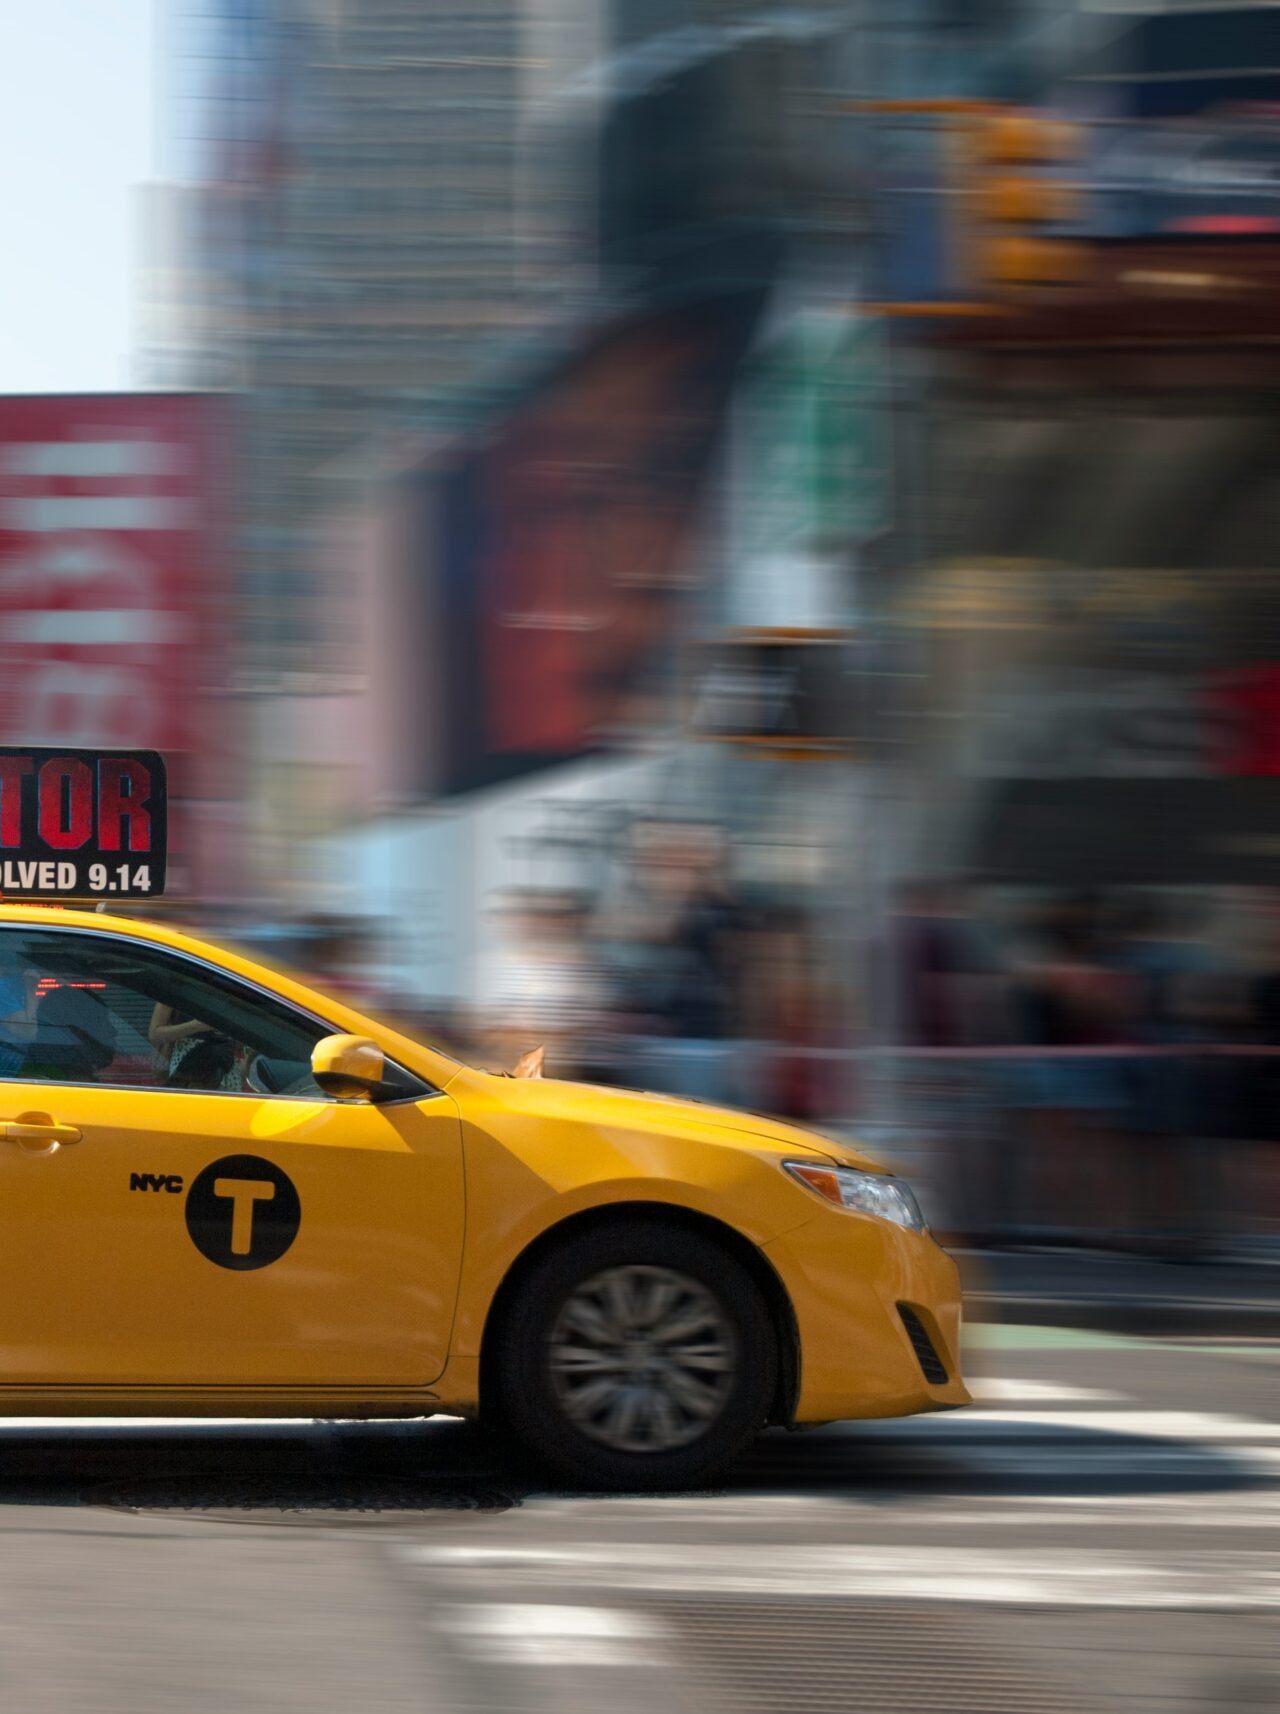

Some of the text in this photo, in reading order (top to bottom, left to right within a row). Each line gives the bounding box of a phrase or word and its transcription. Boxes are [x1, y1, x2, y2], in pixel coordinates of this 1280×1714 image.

[88, 863, 151, 892] 9.14
[130, 1173, 183, 1193] NYC
[214, 1177, 276, 1255] T
